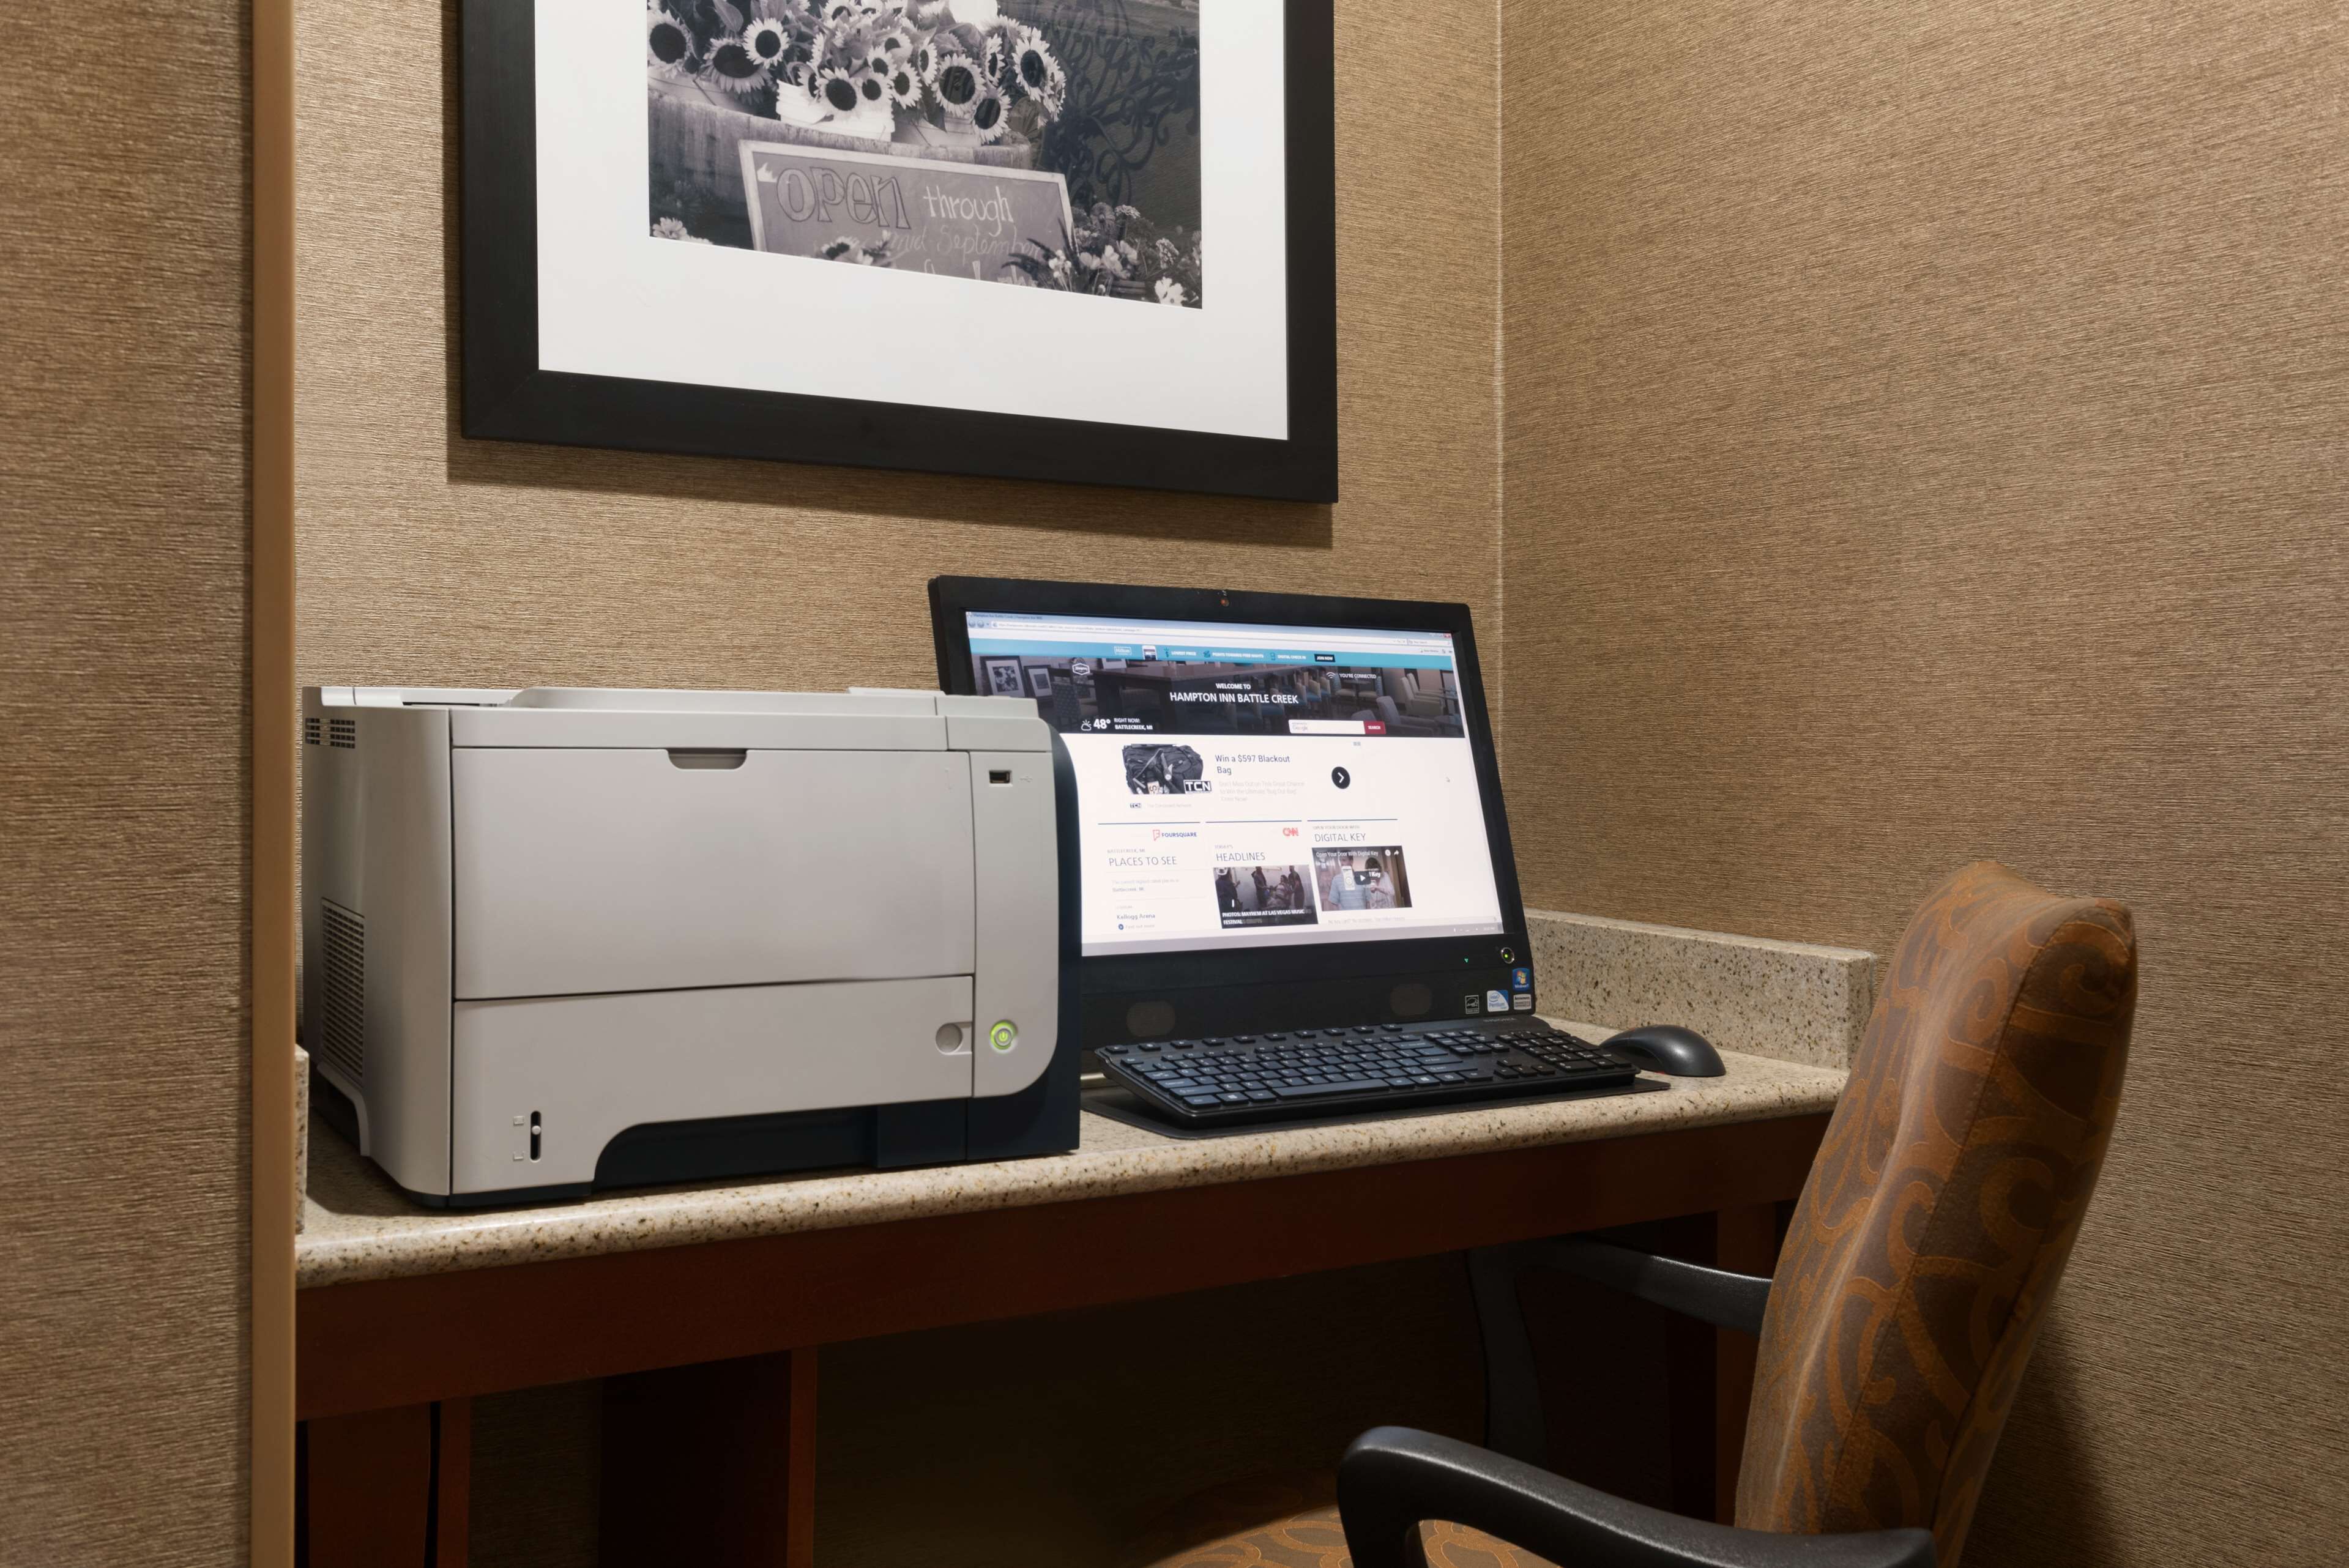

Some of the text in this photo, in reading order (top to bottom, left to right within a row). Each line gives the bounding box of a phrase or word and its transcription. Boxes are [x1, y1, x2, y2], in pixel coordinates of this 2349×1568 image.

[923, 185, 1014, 237] through
[1169, 692, 1299, 704] HAMPTON INN BATTLE CREEK
[1093, 718, 1111, 729] 48°
[1237, 754, 1256, 764] $597
[1258, 754, 1290, 764] Blackout
[1216, 766, 1232, 776] Bag
[1185, 781, 1212, 792] TCN
[1282, 827, 1300, 837] CNN
[1315, 833, 1366, 842] DIGITAL KEY
[1109, 857, 1144, 866] PLACES
[1145, 856, 1159, 866] TO
[1216, 852, 1265, 861] HEADLINES
